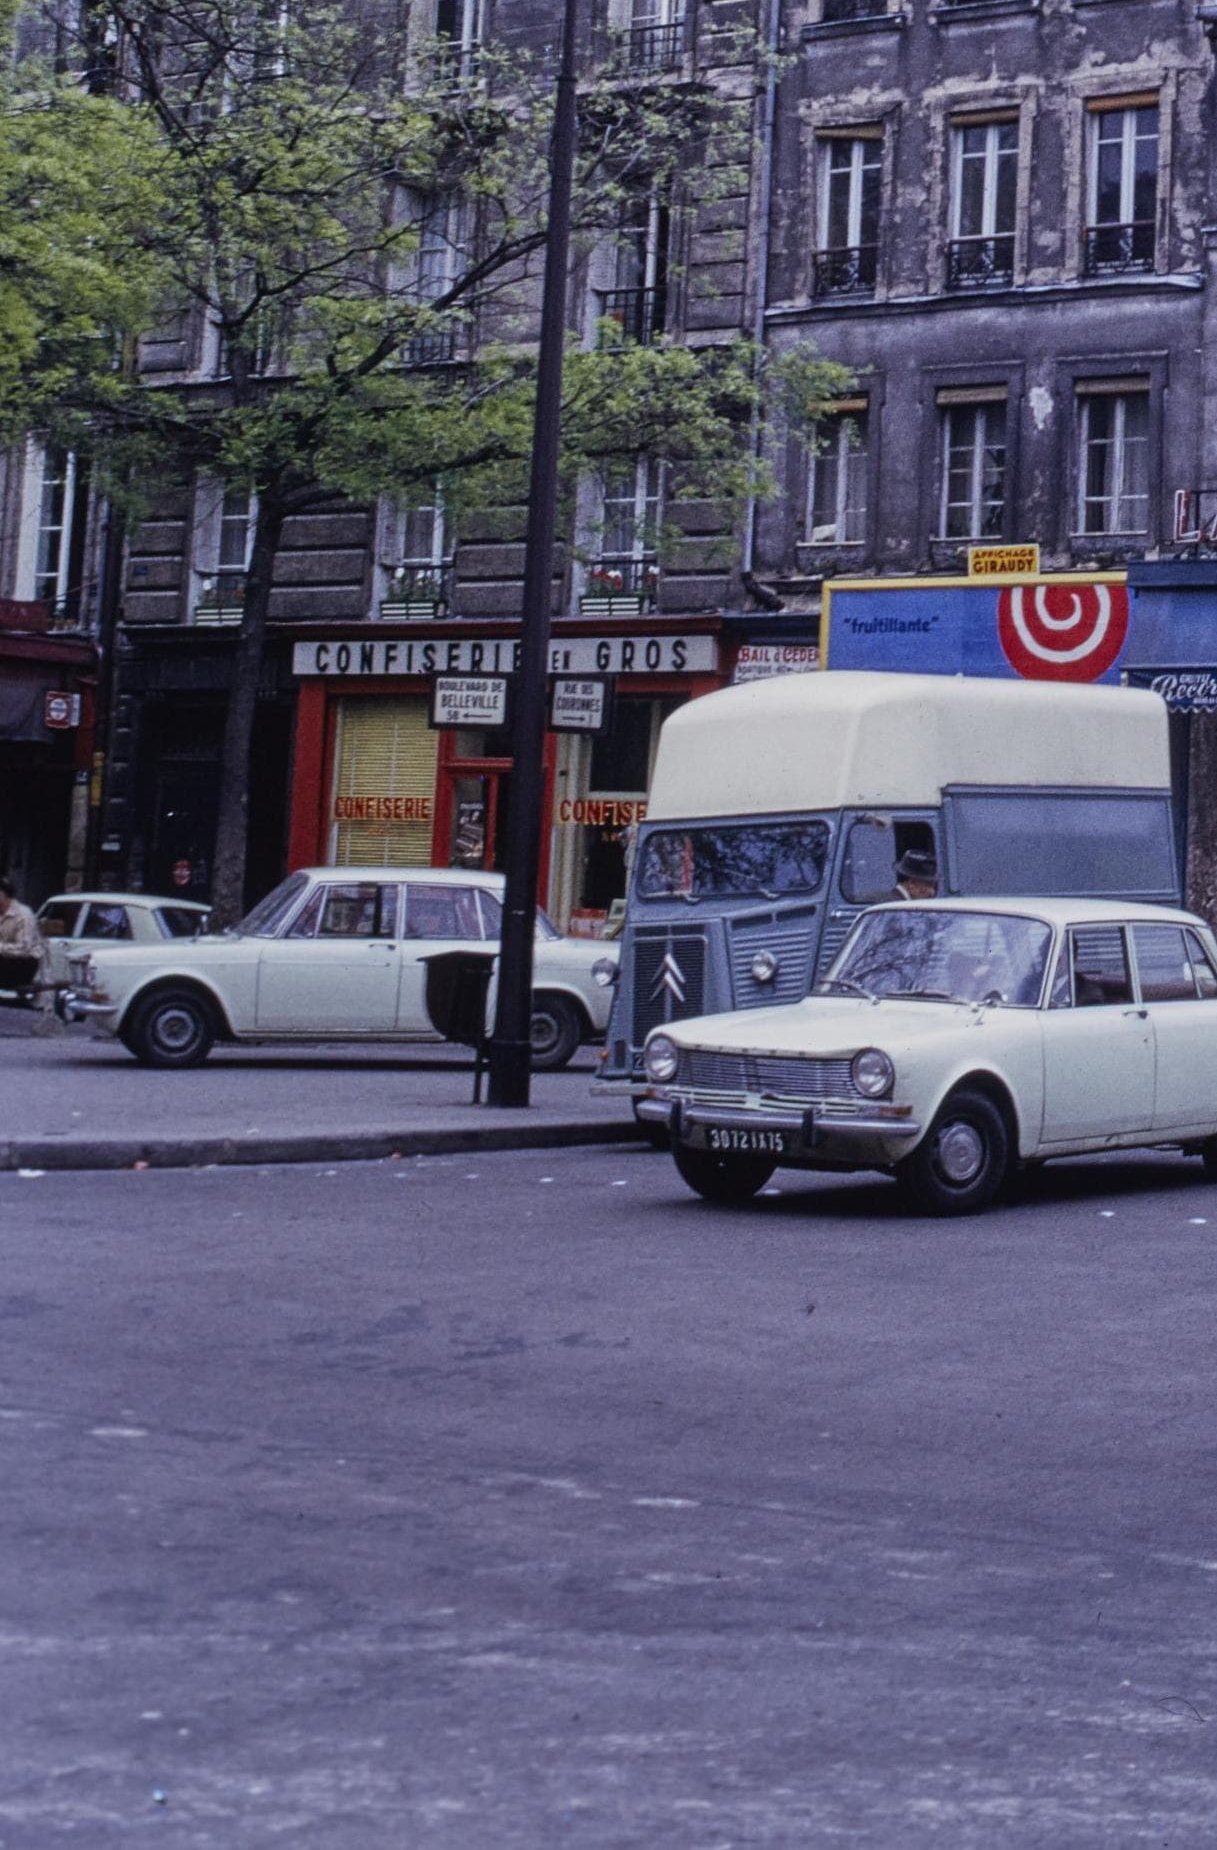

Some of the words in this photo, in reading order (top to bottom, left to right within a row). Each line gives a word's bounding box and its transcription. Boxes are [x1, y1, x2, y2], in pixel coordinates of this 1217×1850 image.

[974, 549, 1035, 559] AFFICHAGE
[973, 558, 1034, 573] GIRAUDY
[315, 643, 523, 673] CONFISERIE
[596, 639, 687, 671] GROS
[742, 646, 771, 662] BAIL
[438, 680, 488, 693] BOULEVARD
[491, 682, 503, 693] DE
[440, 694, 500, 709] BELLEVILLE
[335, 796, 434, 819] CONFISERIE
